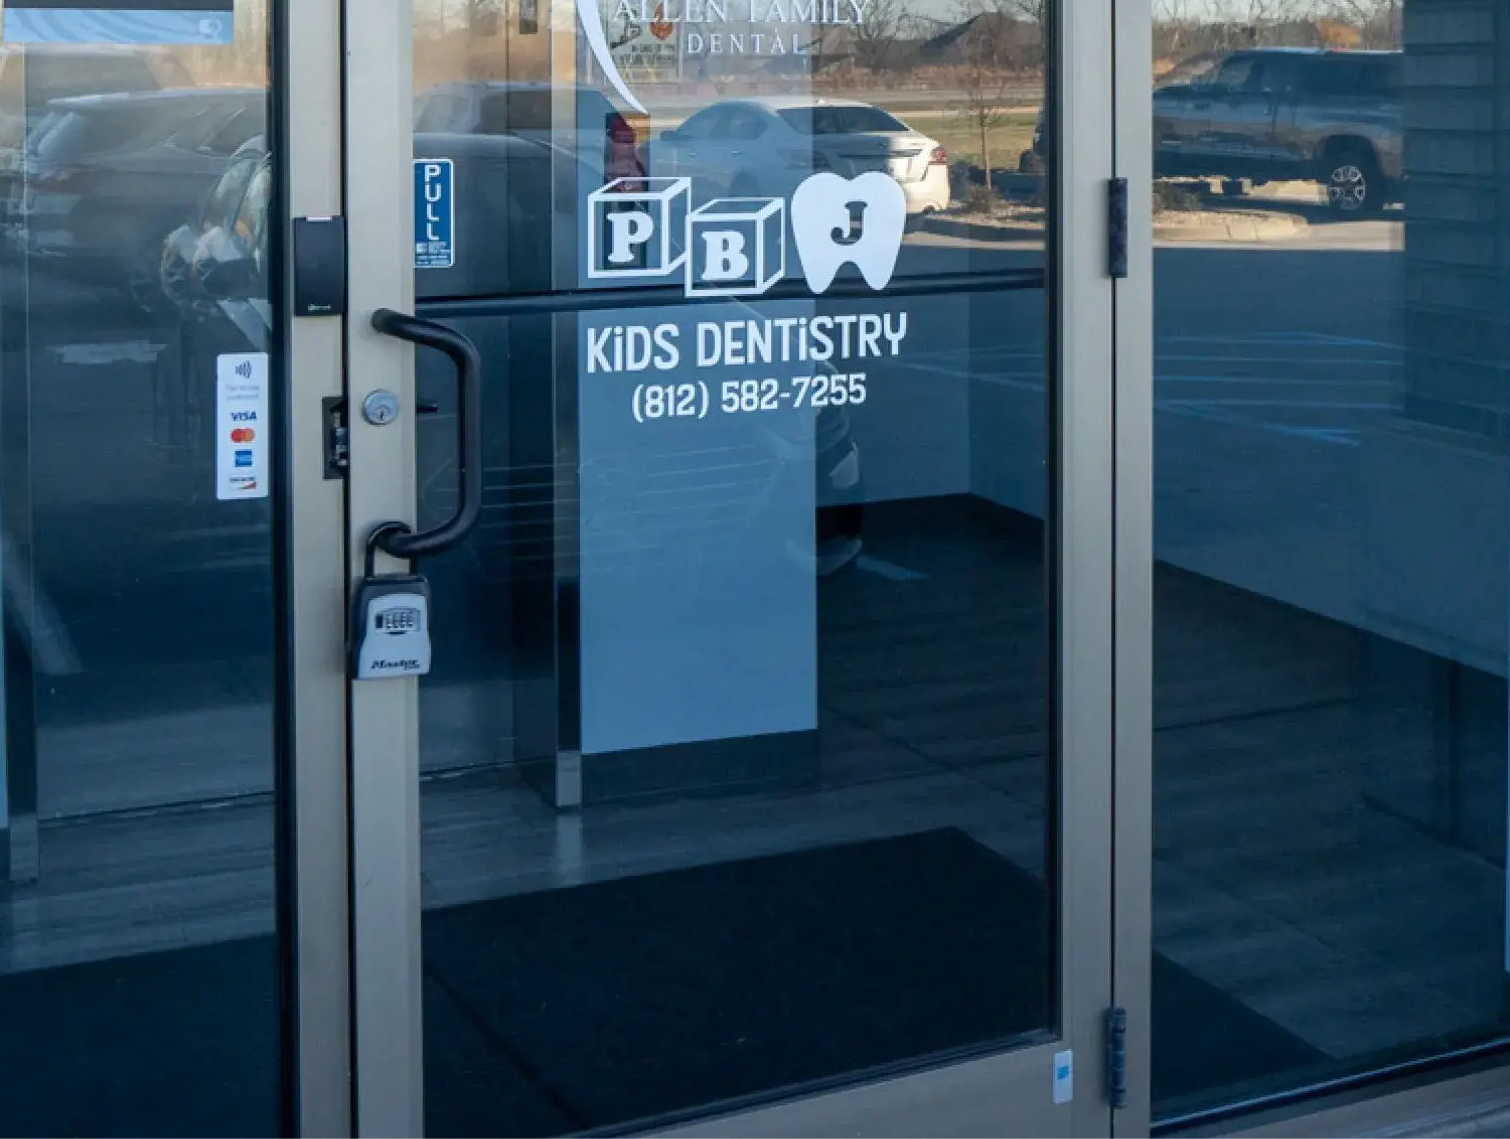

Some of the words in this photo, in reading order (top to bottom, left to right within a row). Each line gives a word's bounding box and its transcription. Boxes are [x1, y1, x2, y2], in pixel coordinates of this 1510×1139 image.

[687, 29, 808, 55] DENTAL
[424, 164, 442, 241] PULL
[230, 411, 258, 422] VISA
[632, 382, 709, 423] (812)
[721, 372, 867, 414] 582-7255
